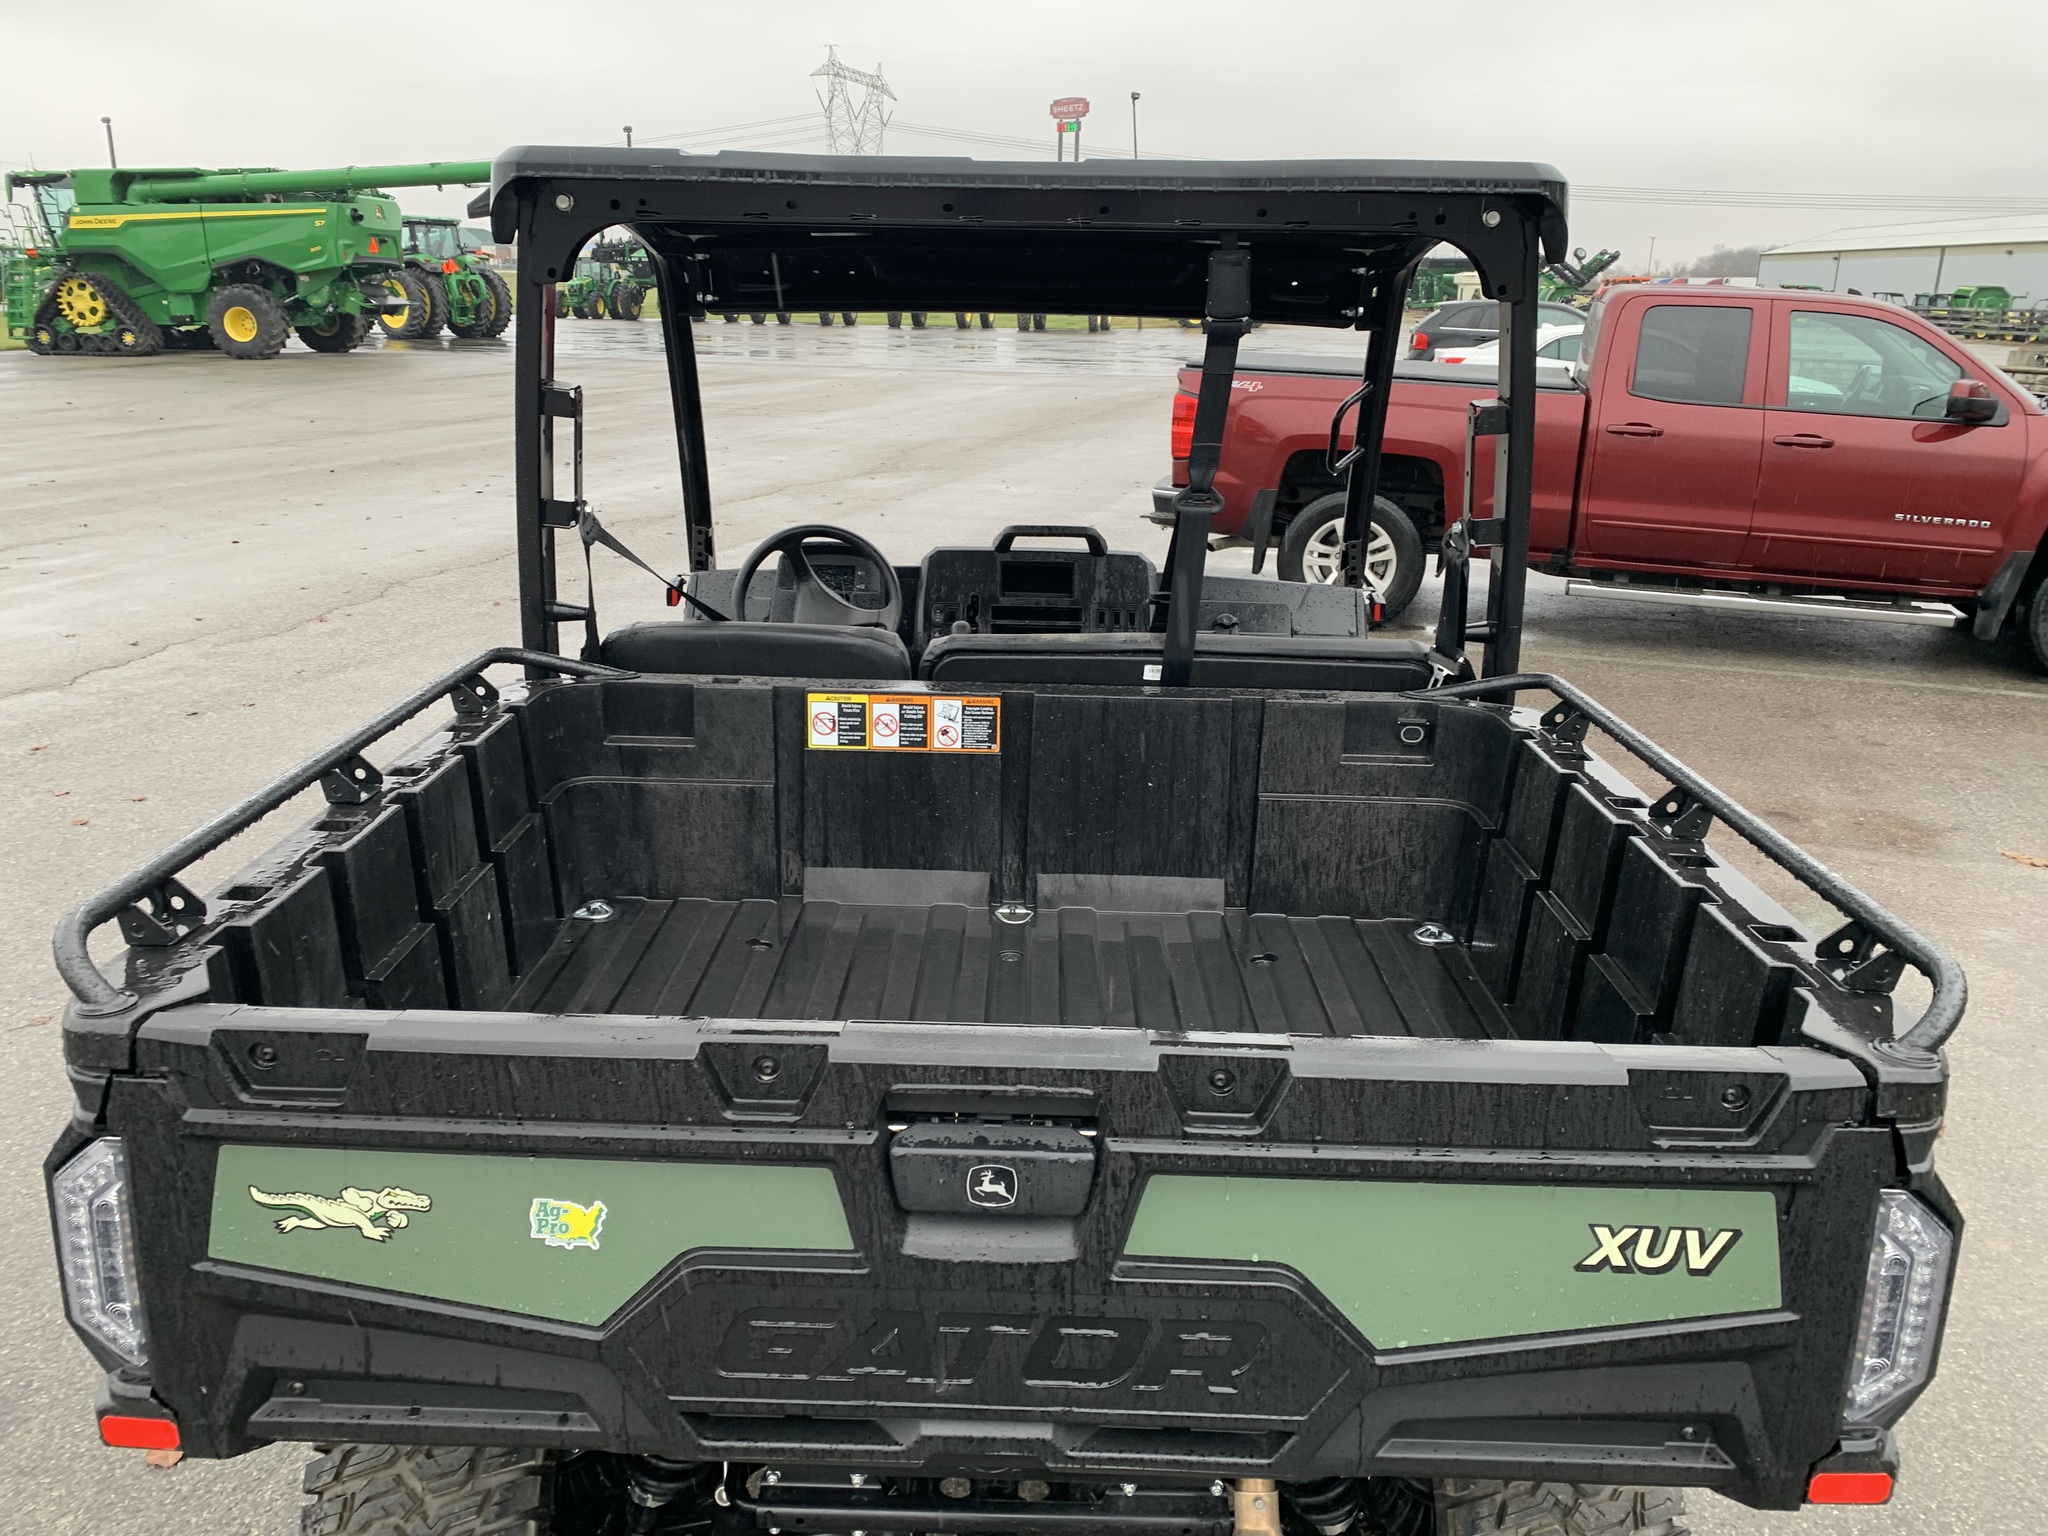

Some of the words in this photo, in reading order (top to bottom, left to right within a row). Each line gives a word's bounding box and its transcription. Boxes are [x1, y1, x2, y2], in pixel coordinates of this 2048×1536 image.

[1052, 103, 1084, 113] SHEETZ
[1894, 513, 1991, 528] SILVERADO
[535, 1202, 569, 1220] Ag-
[536, 1218, 570, 1234] Pro
[1573, 1223, 1743, 1277] XUV
[715, 1306, 1268, 1394] GATOR
